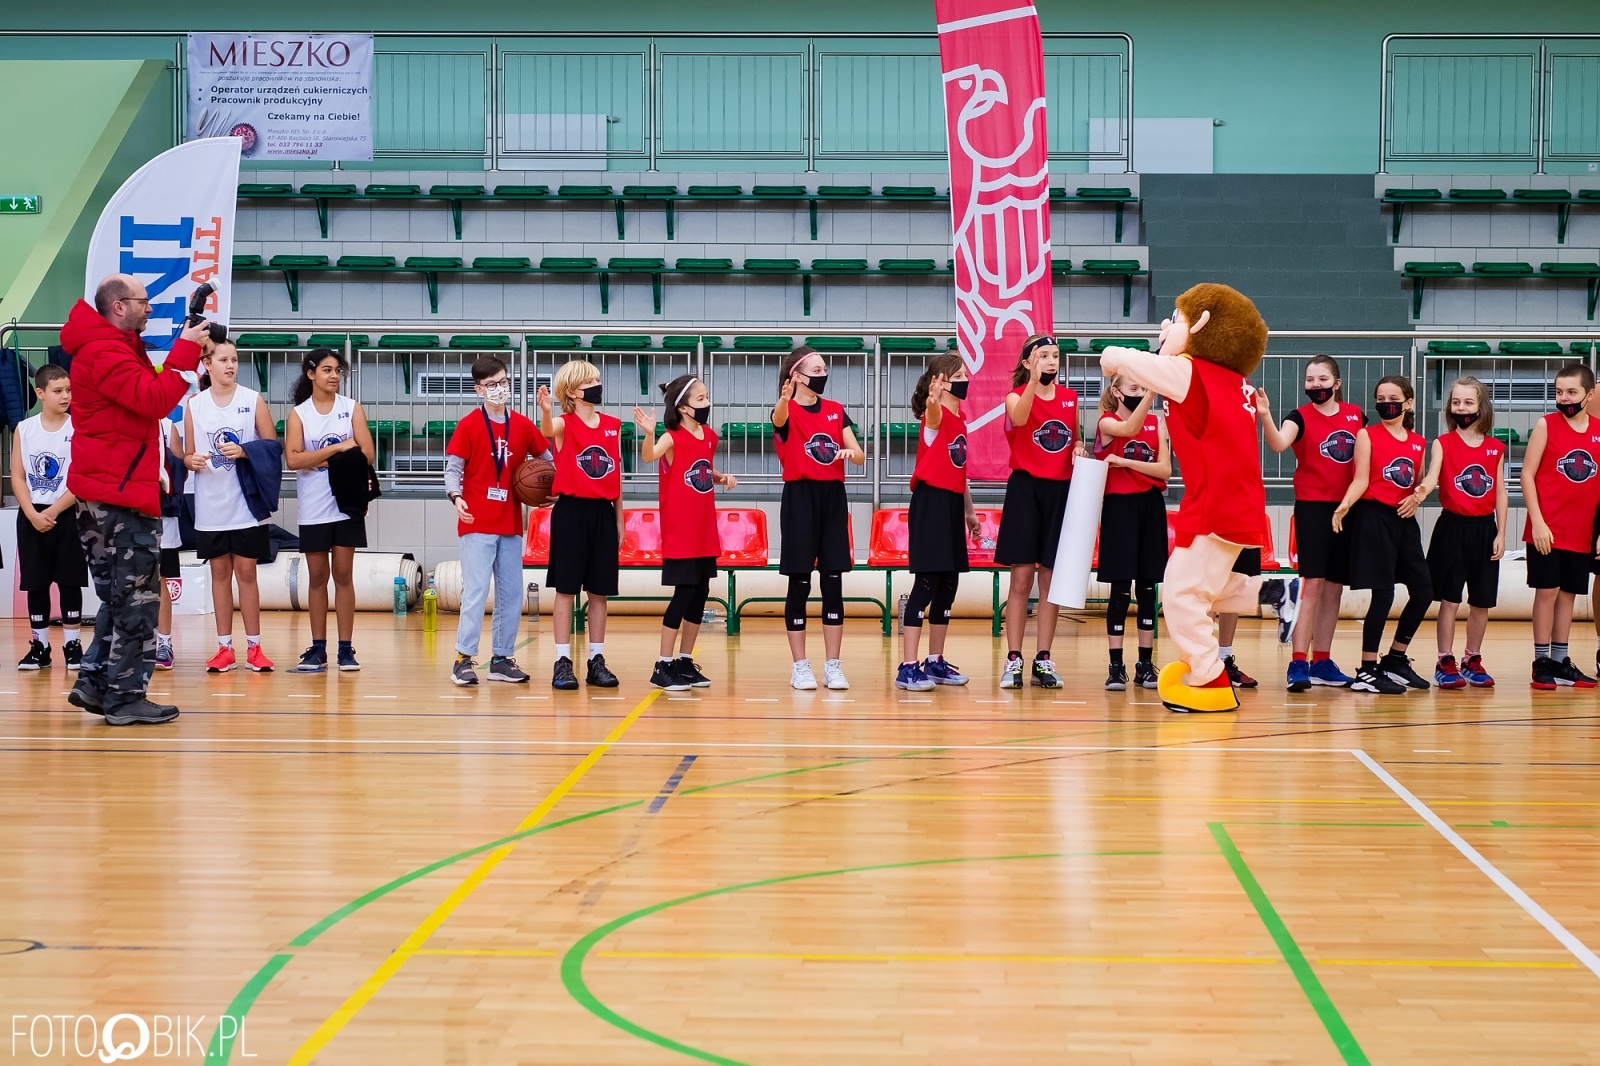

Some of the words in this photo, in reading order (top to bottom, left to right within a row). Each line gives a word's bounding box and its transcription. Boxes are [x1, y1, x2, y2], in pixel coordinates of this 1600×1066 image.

[209, 40, 351, 68] MIESZKO
[211, 85, 254, 94] Operator
[257, 85, 300, 95] urządzeń
[303, 86, 368, 95] cukierniczych
[211, 96, 261, 104] Pracownik
[263, 96, 323, 106] produkcyjny
[267, 112, 311, 122] Czekamy
[328, 112, 360, 121] Ciebie!
[322, 135, 358, 143] Starowiejska
